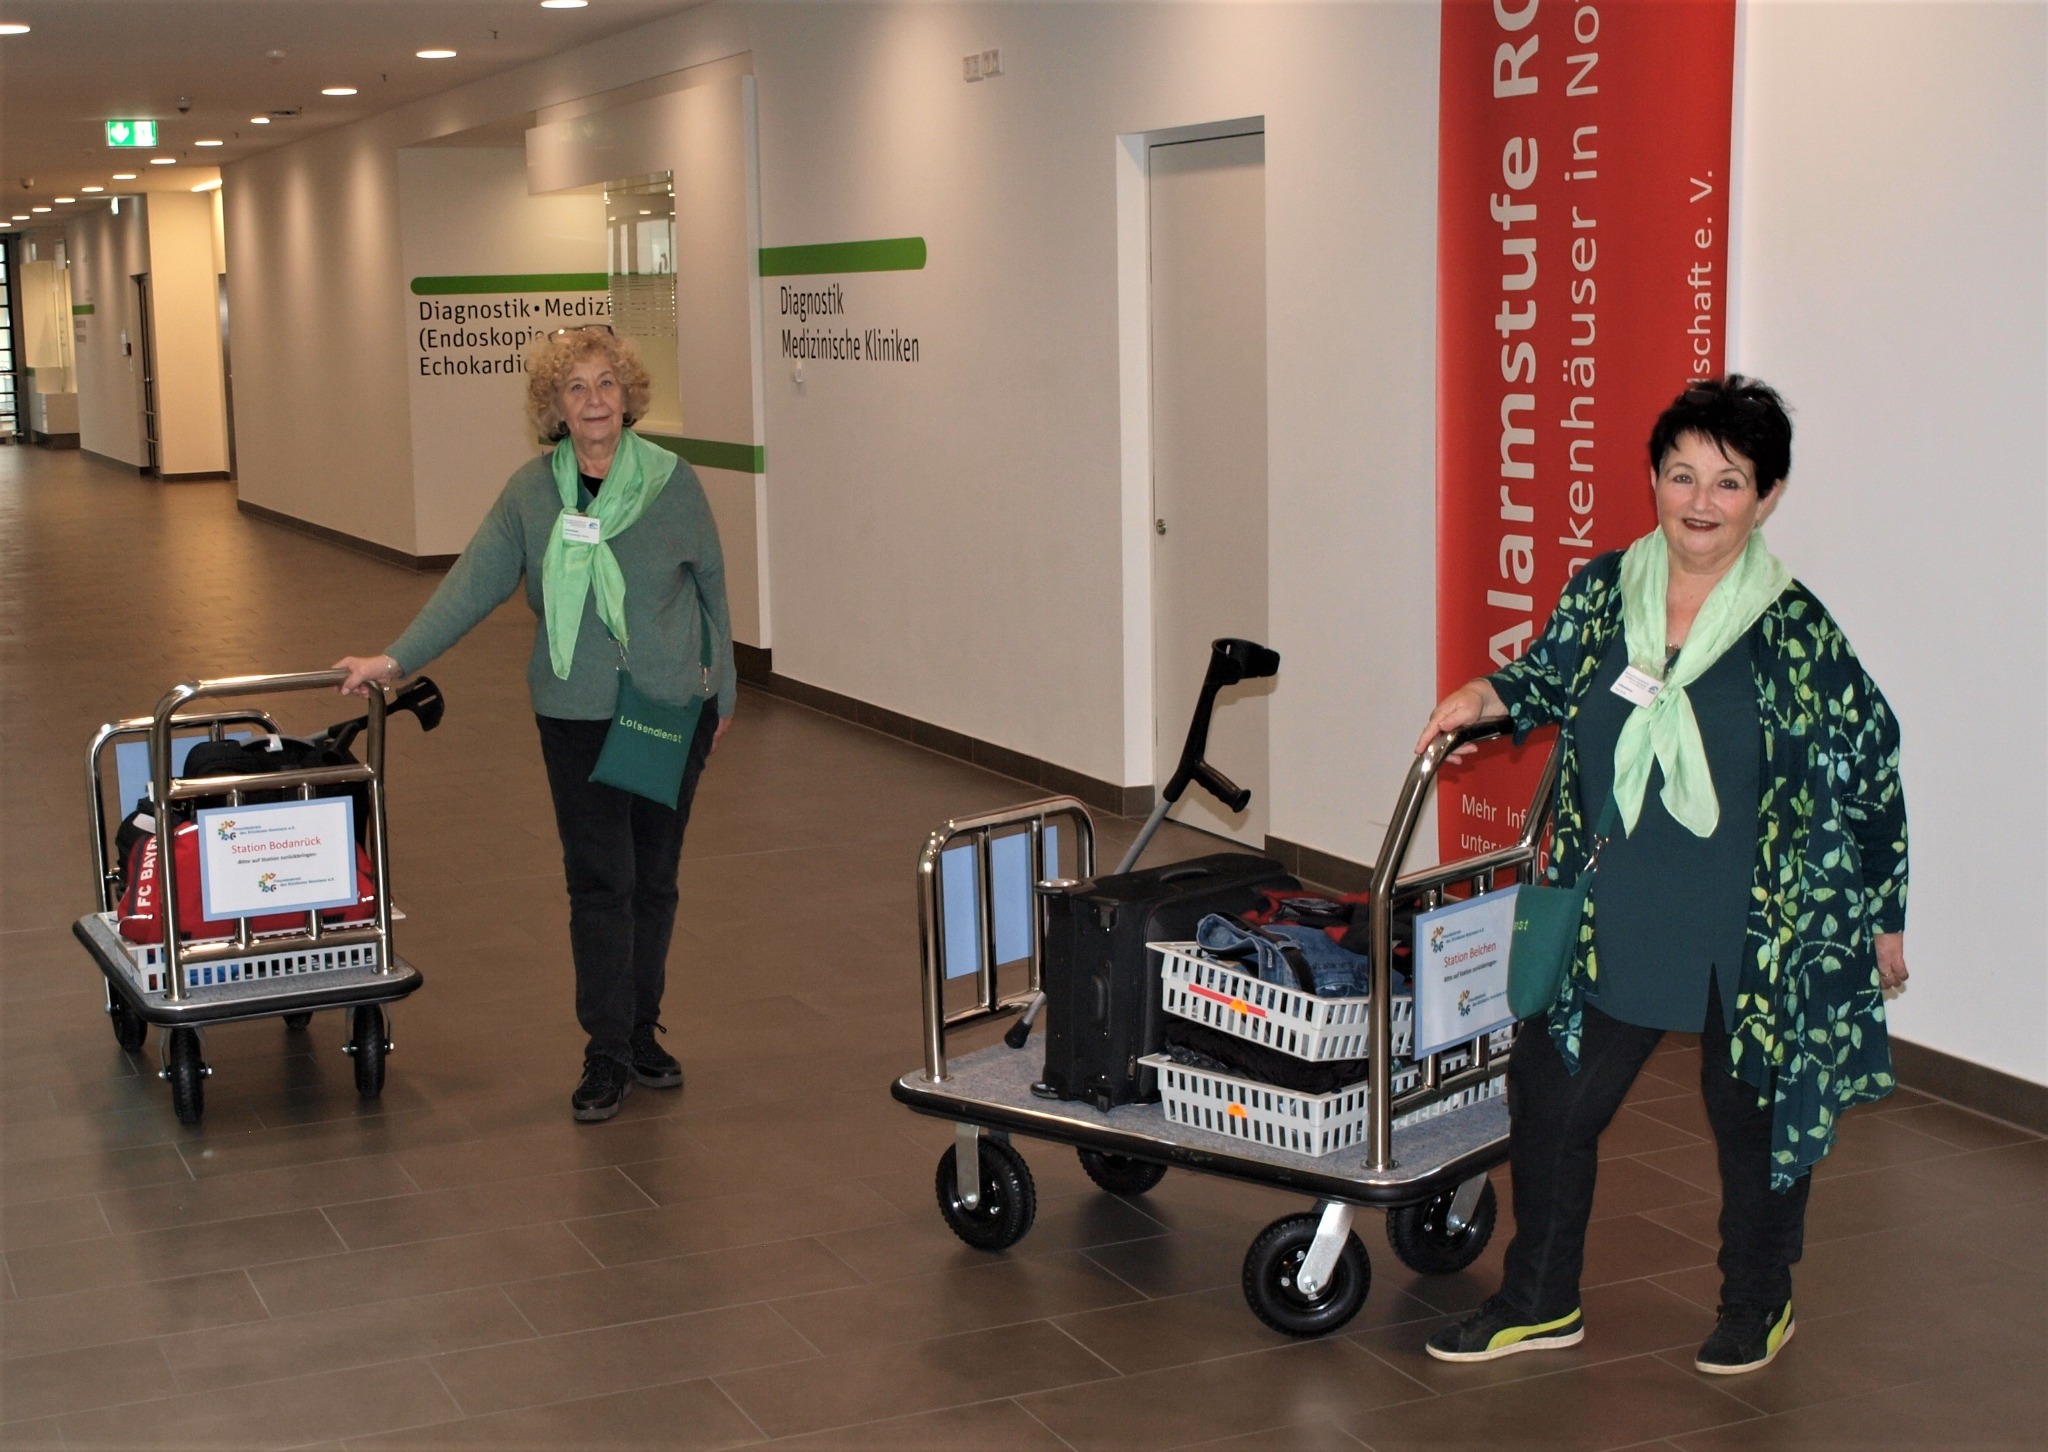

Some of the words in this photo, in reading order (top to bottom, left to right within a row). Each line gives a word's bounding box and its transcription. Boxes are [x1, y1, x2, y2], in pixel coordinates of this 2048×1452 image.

[1566, 0, 1600, 97] No
[1564, 125, 1598, 181] in
[1689, 170, 1713, 204] V.
[780, 282, 844, 322] Diagnostik
[782, 328, 861, 360] Medizinische
[864, 328, 920, 363] Kliniken
[1486, 136, 1539, 669] Alarmstufe
[619, 715, 682, 744] Lotsendienst
[1461, 793, 1498, 823] Mehr
[231, 843, 267, 855] Station
[269, 836, 322, 851] Bodanrück
[137, 884, 152, 907] FC
[1443, 952, 1468, 968] Station
[1469, 942, 1496, 959] Belchen
